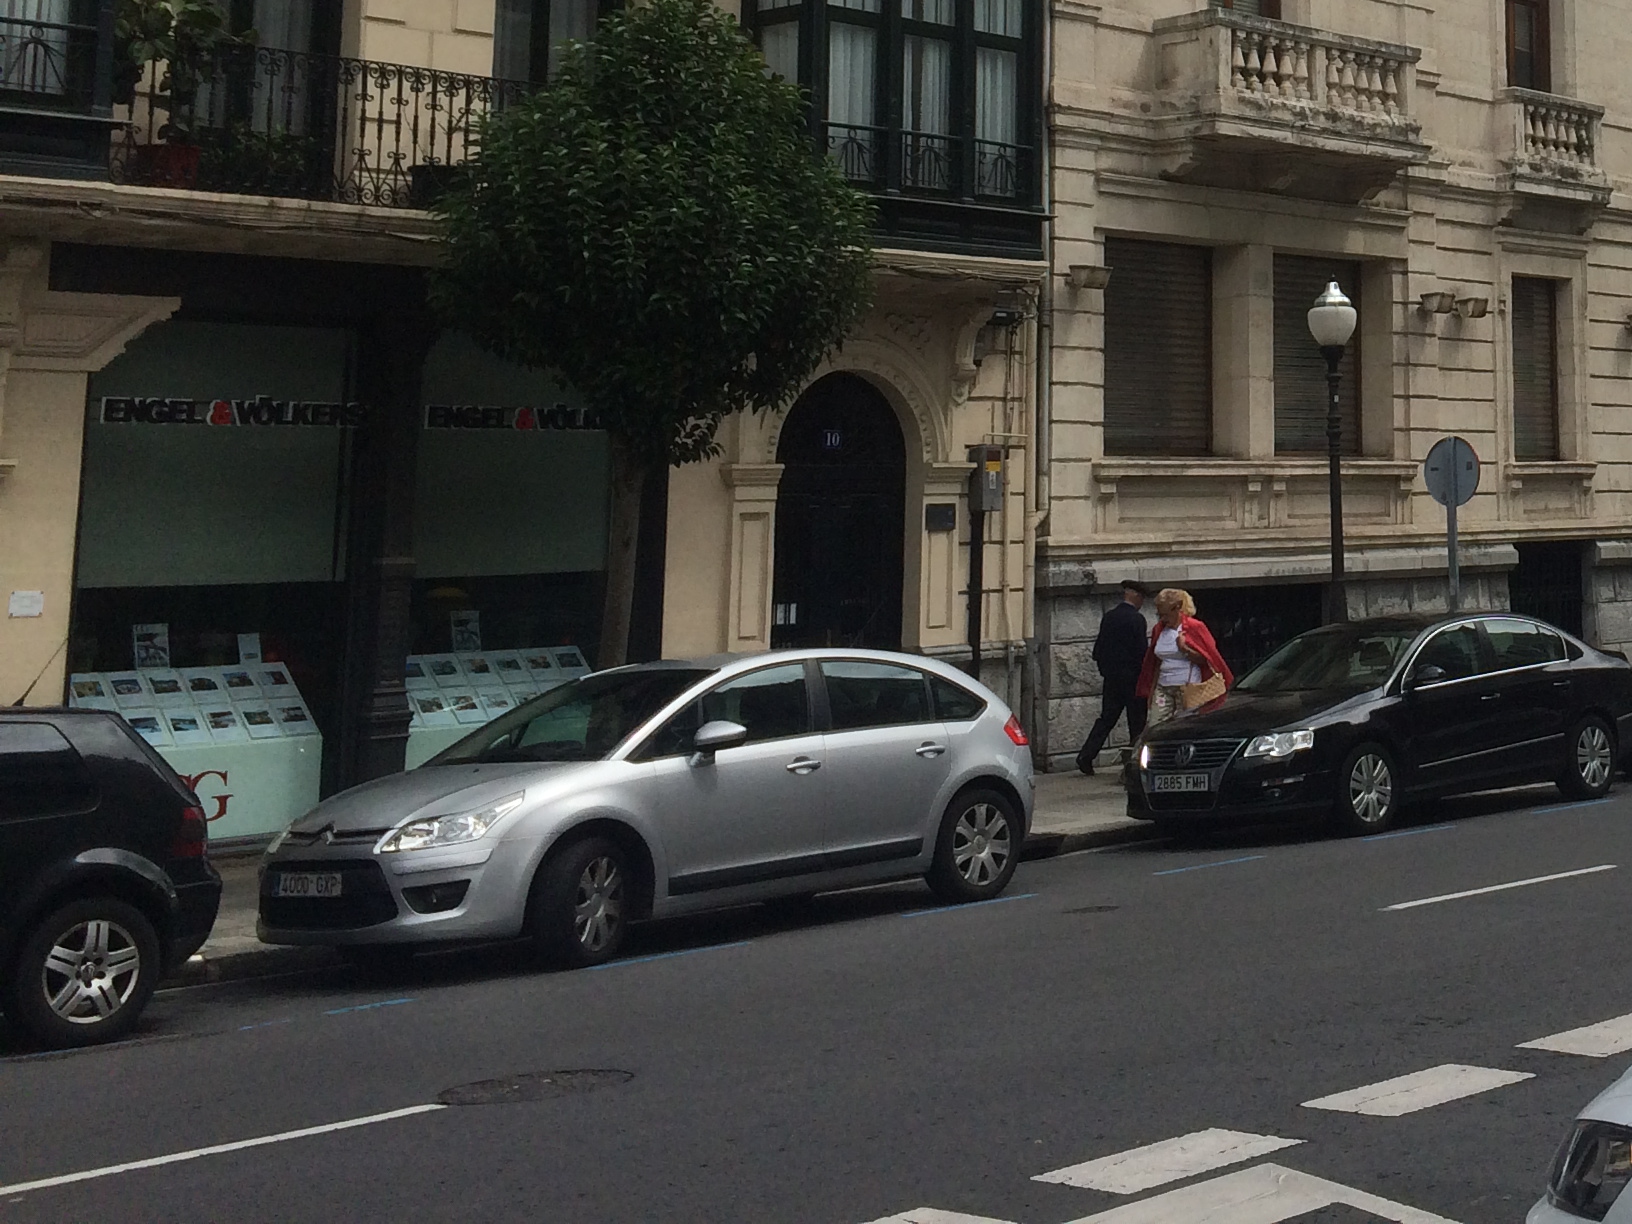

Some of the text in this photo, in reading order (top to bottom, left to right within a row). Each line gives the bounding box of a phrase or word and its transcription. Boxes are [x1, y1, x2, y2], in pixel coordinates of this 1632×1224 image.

[100, 396, 203, 425] ENGEL
[206, 399, 232, 426] &
[424, 404, 513, 430] ENGEL
[511, 407, 534, 430] &
[826, 432, 840, 446] 10
[1157, 775, 1206, 790] 2885 FMH
[316, 876, 338, 894] GXP
